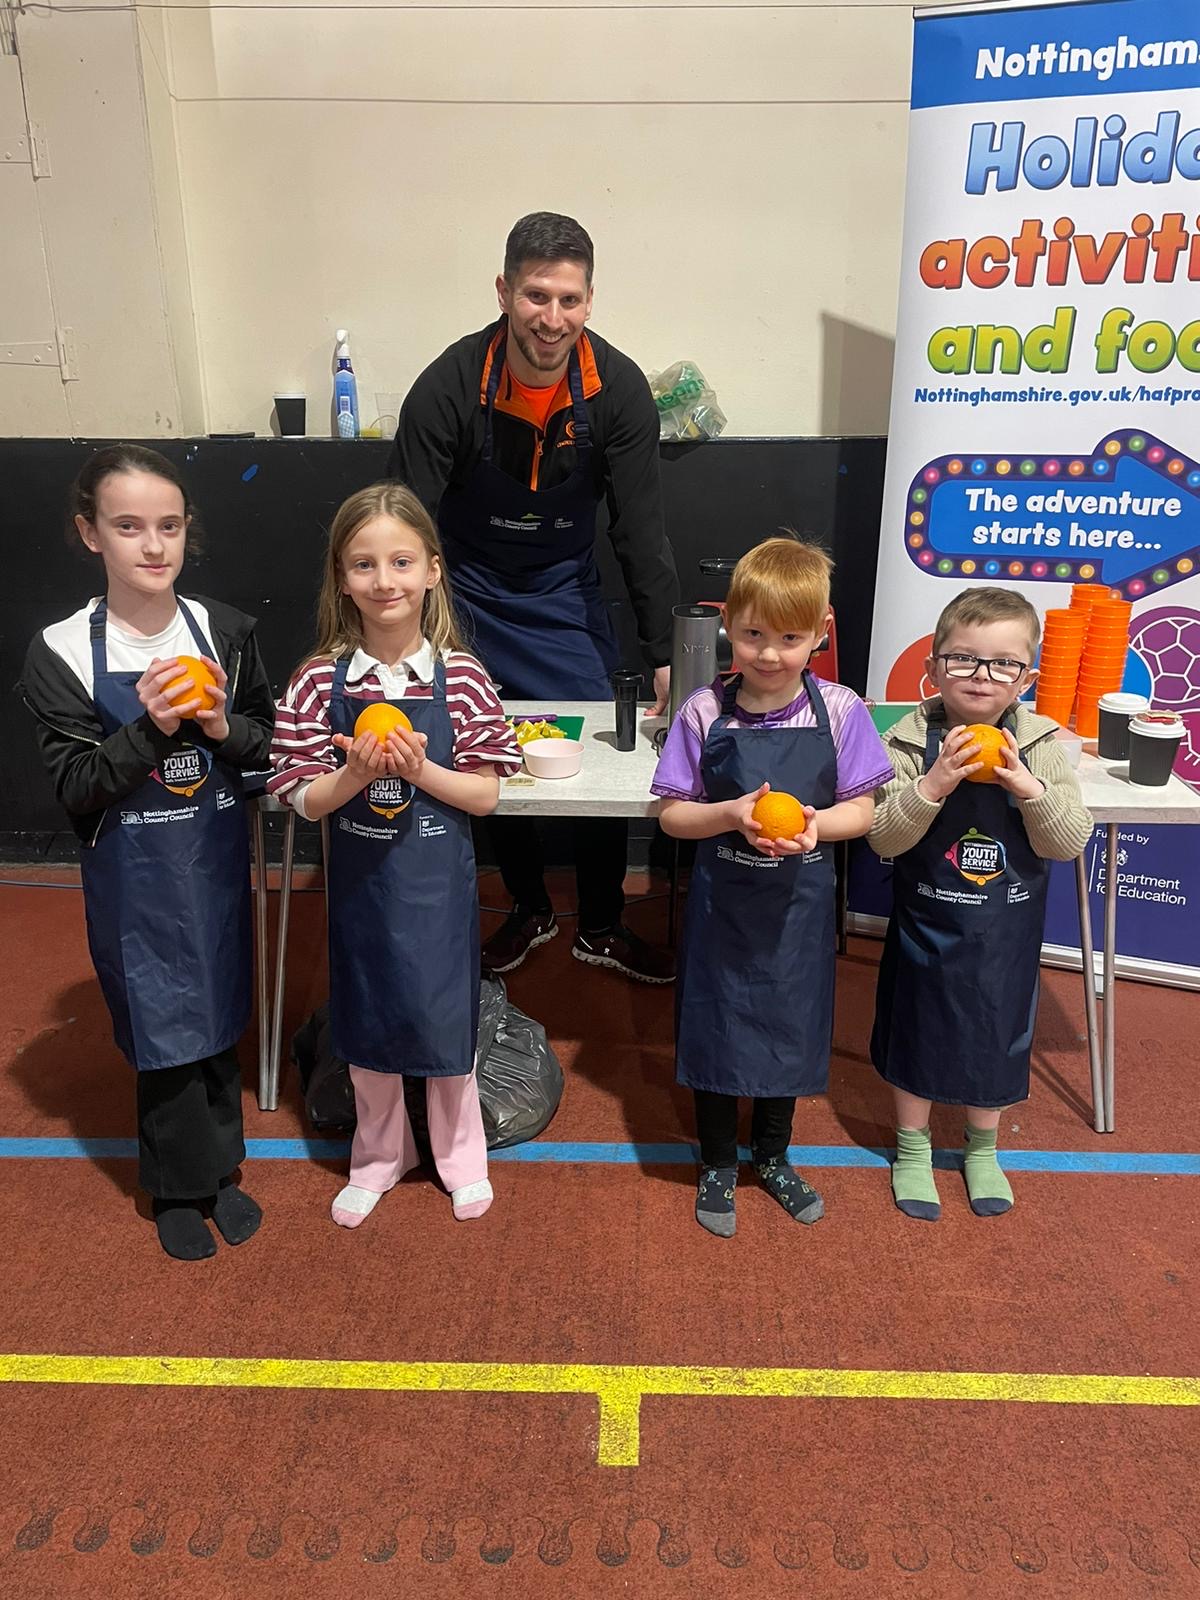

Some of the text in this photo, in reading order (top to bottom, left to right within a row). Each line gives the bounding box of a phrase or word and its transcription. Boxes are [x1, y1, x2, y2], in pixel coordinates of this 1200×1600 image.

[975, 35, 1200, 81] Nottingham
[927, 306, 1077, 375] and
[965, 488, 1182, 517] The adventure
[972, 521, 1162, 550] starts here...
[163, 754, 200, 771] YOUTH
[164, 766, 201, 779] SERVICE
[369, 789, 402, 800] SERVICE
[143, 806, 200, 818] Nottinghamshire
[143, 811, 194, 824] County Council
[352, 828, 393, 840] County Council
[1095, 829, 1150, 845] Fued by
[962, 846, 998, 860] YOUTH
[961, 857, 997, 868] SERVICE
[1098, 868, 1181, 890] Dpartment
[935, 888, 989, 900] Nottinghamshire
[935, 894, 982, 906] County Council
[1096, 882, 1187, 906] fo Education
